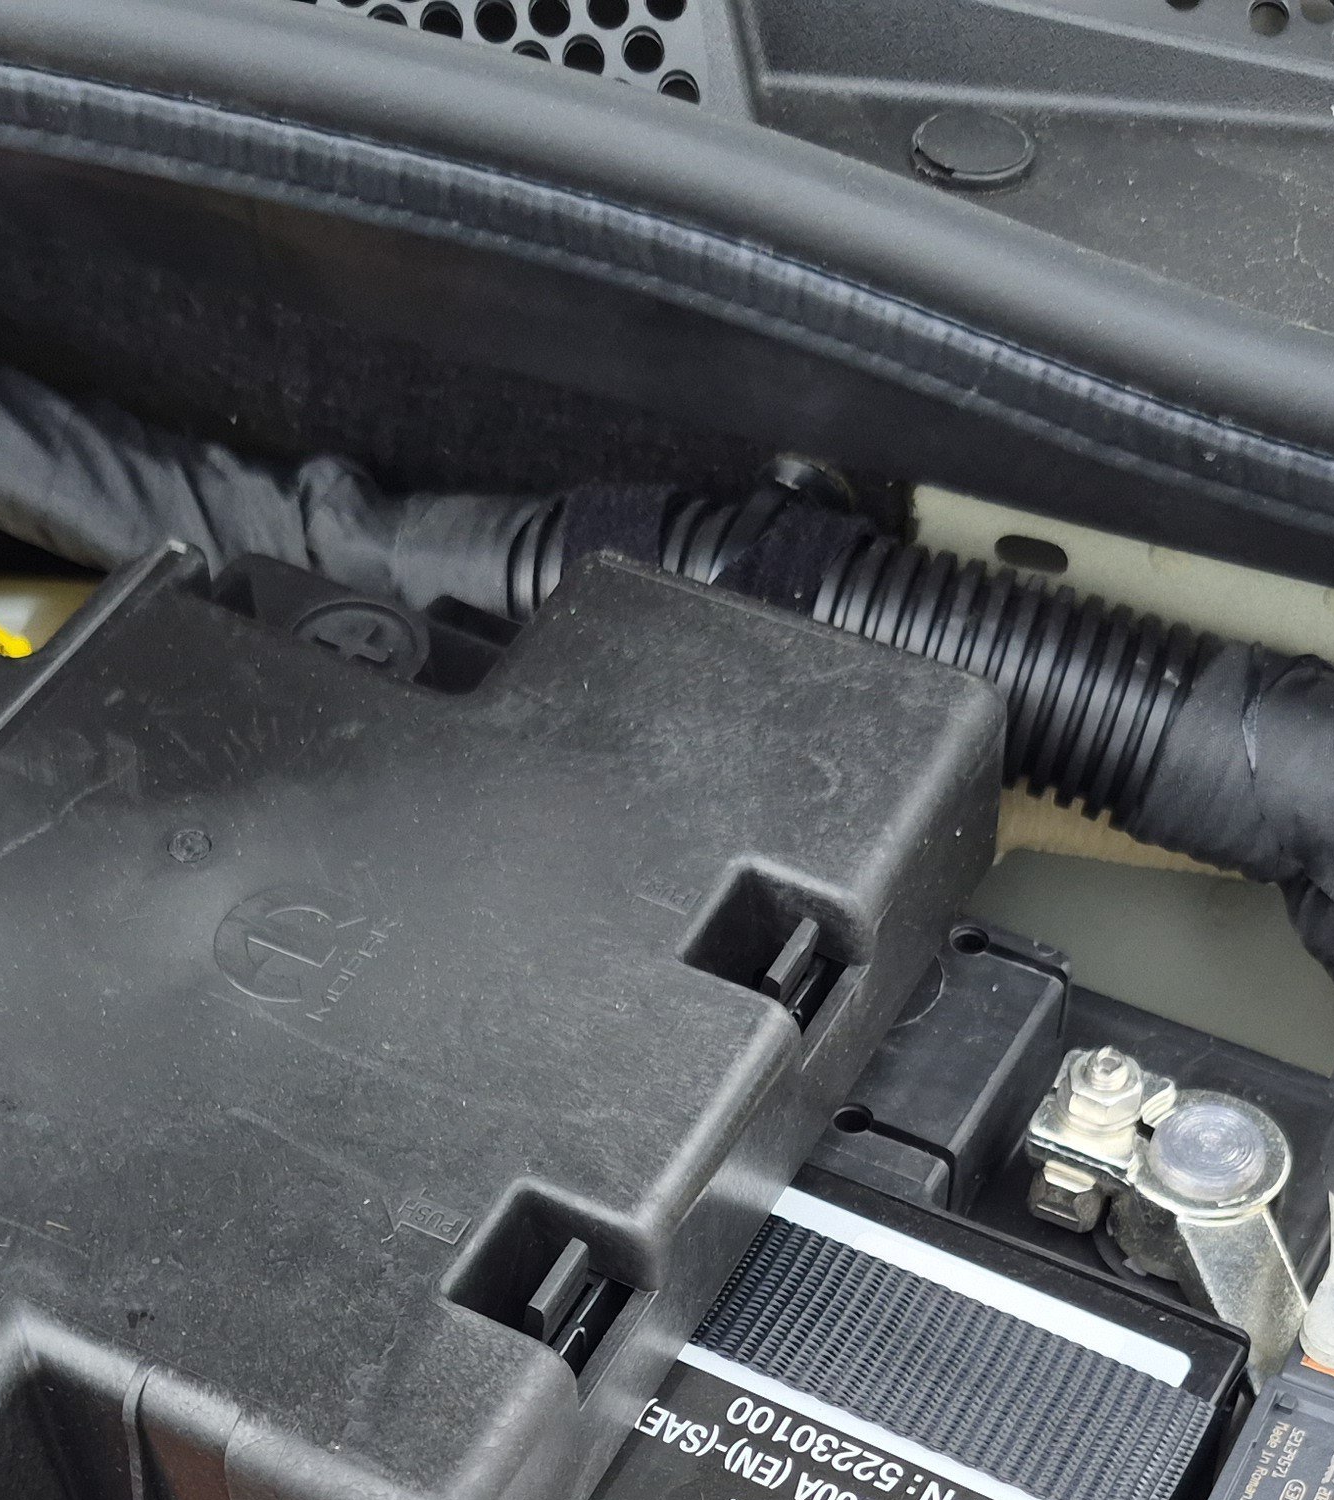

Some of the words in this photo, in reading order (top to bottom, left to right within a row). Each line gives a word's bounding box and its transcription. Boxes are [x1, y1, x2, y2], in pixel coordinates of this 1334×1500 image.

[398, 1196, 458, 1236] PUSH
[634, 1397, 794, 1490] (EN)-(SAE)
[726, 1396, 905, 1493] 52230100
[1266, 1421, 1291, 1449] Made
[1259, 1449, 1275, 1464] in
